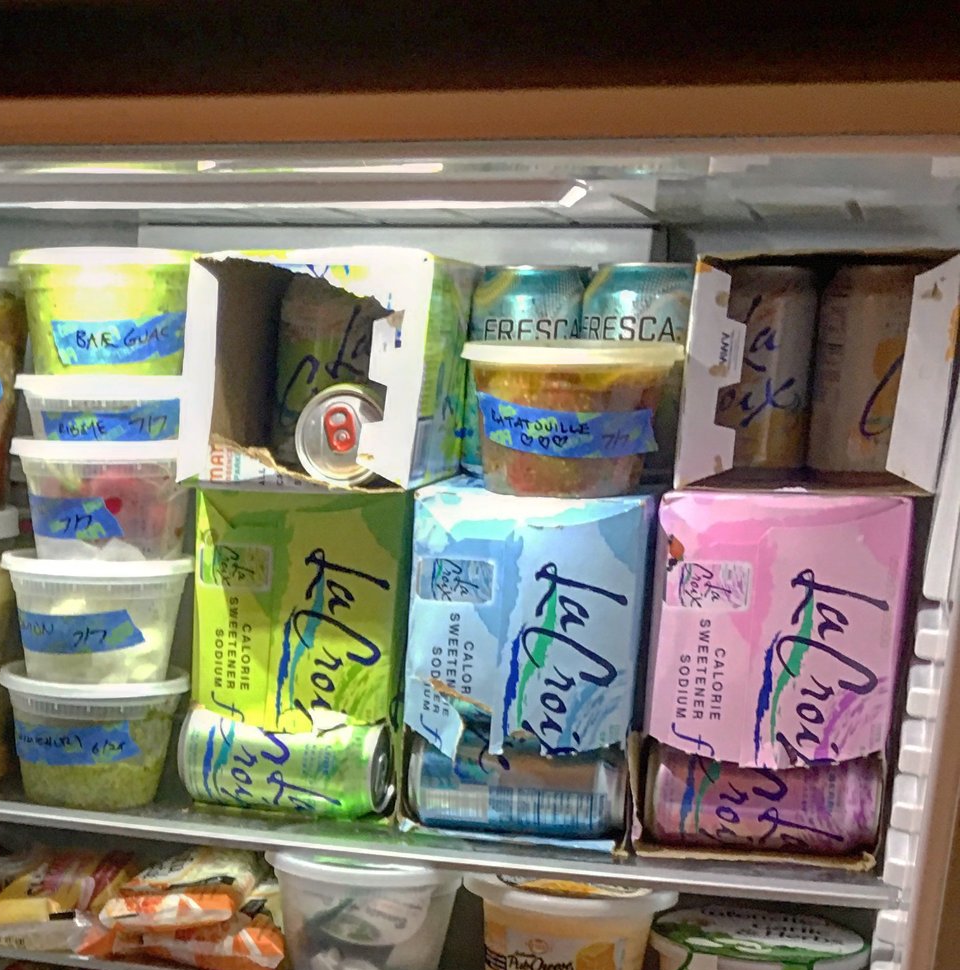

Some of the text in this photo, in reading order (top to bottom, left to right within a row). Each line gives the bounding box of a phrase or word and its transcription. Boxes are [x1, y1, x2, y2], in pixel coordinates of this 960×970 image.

[484, 318, 581, 341] FRESCA
[214, 628, 224, 688] SODIUM
[226, 597, 239, 690] SWEETENER
[240, 624, 252, 691] CALORIE
[692, 618, 711, 720] SWEETENER
[676, 655, 691, 719] SODIUM
[709, 647, 726, 721] CALORIE
